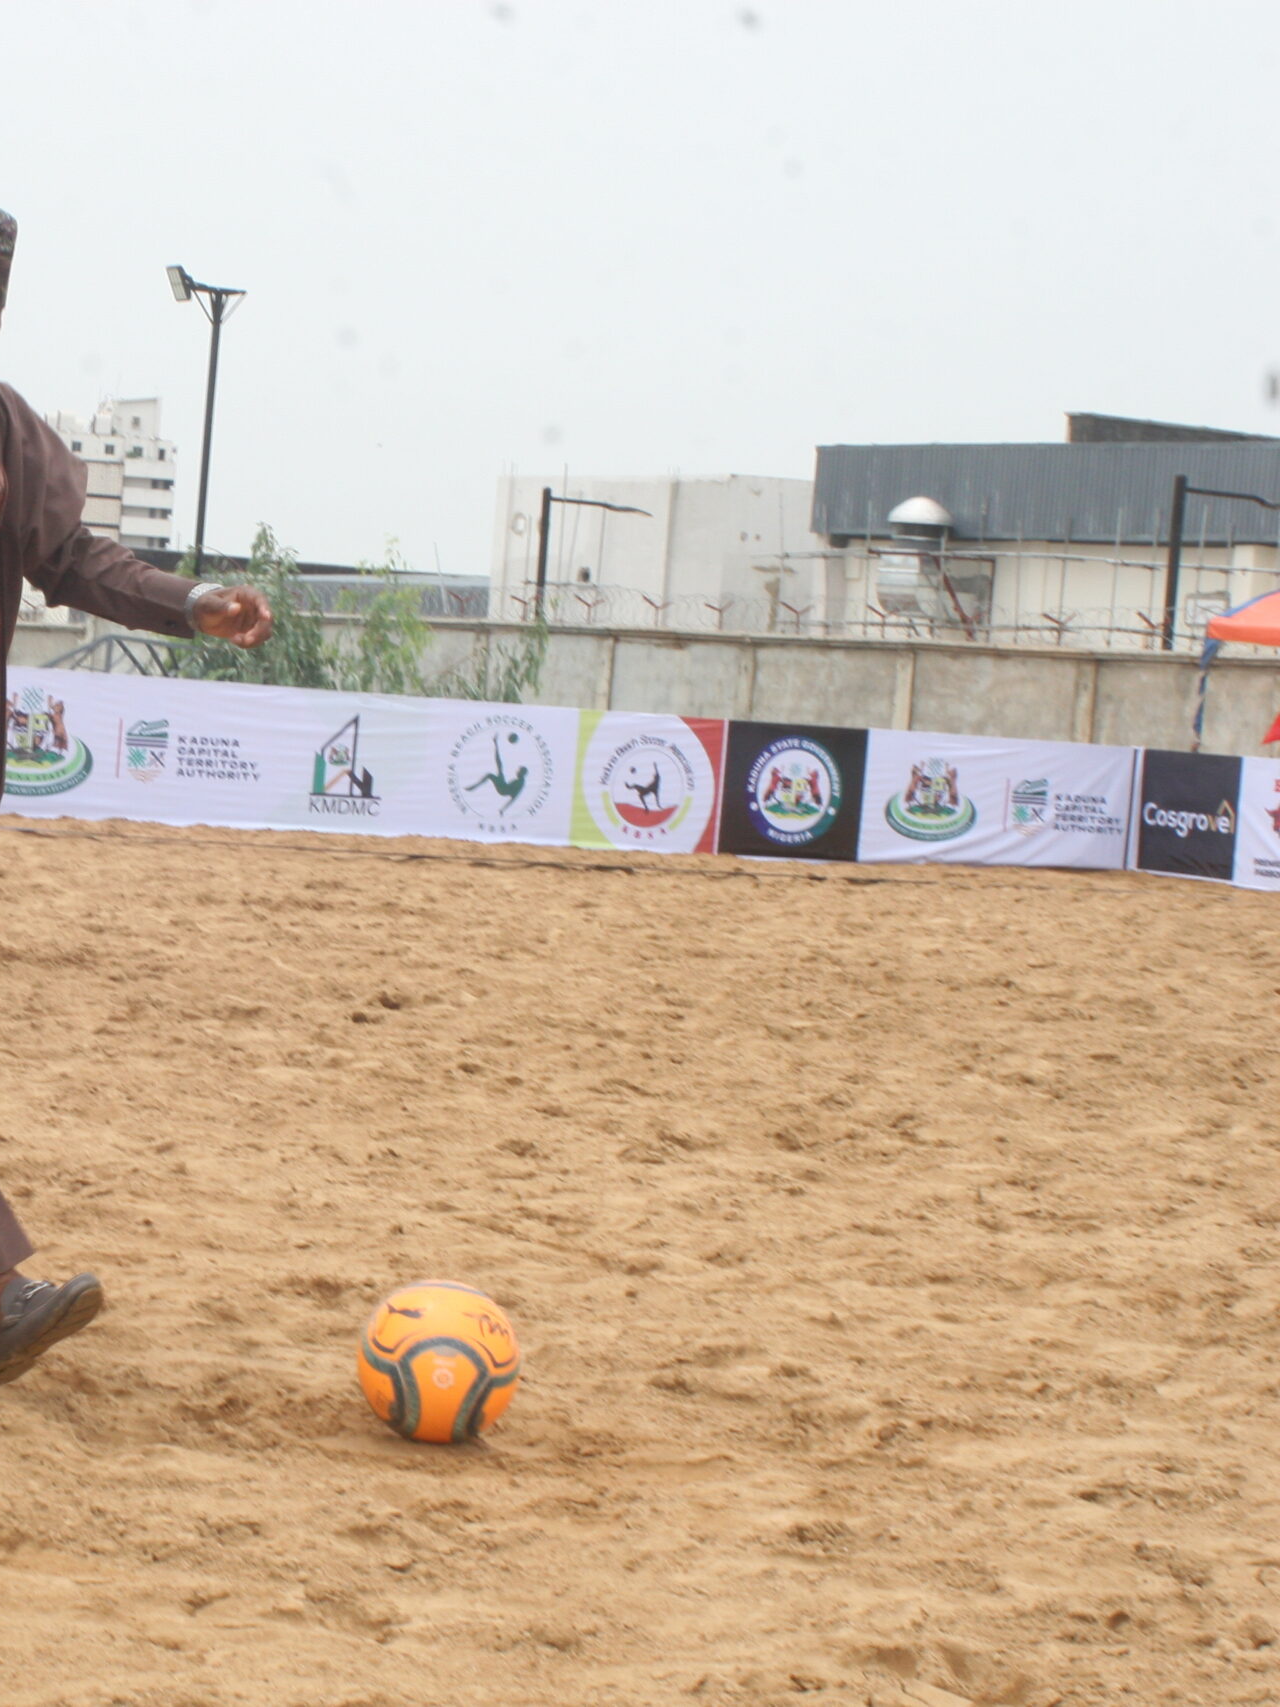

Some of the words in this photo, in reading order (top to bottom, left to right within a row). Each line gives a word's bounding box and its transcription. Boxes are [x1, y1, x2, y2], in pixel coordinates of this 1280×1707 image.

[178, 735, 240, 748] KADUNA
[177, 746, 239, 759] CAPITAL
[176, 757, 257, 770] TERRITORY
[747, 751, 771, 793] KADUNA
[769, 738, 800, 755] STATE
[176, 767, 261, 781] AUTHORITY
[309, 797, 380, 817] KMDMC
[1143, 800, 1235, 838] Cosgrove
[767, 828, 814, 844] NIGERIA
